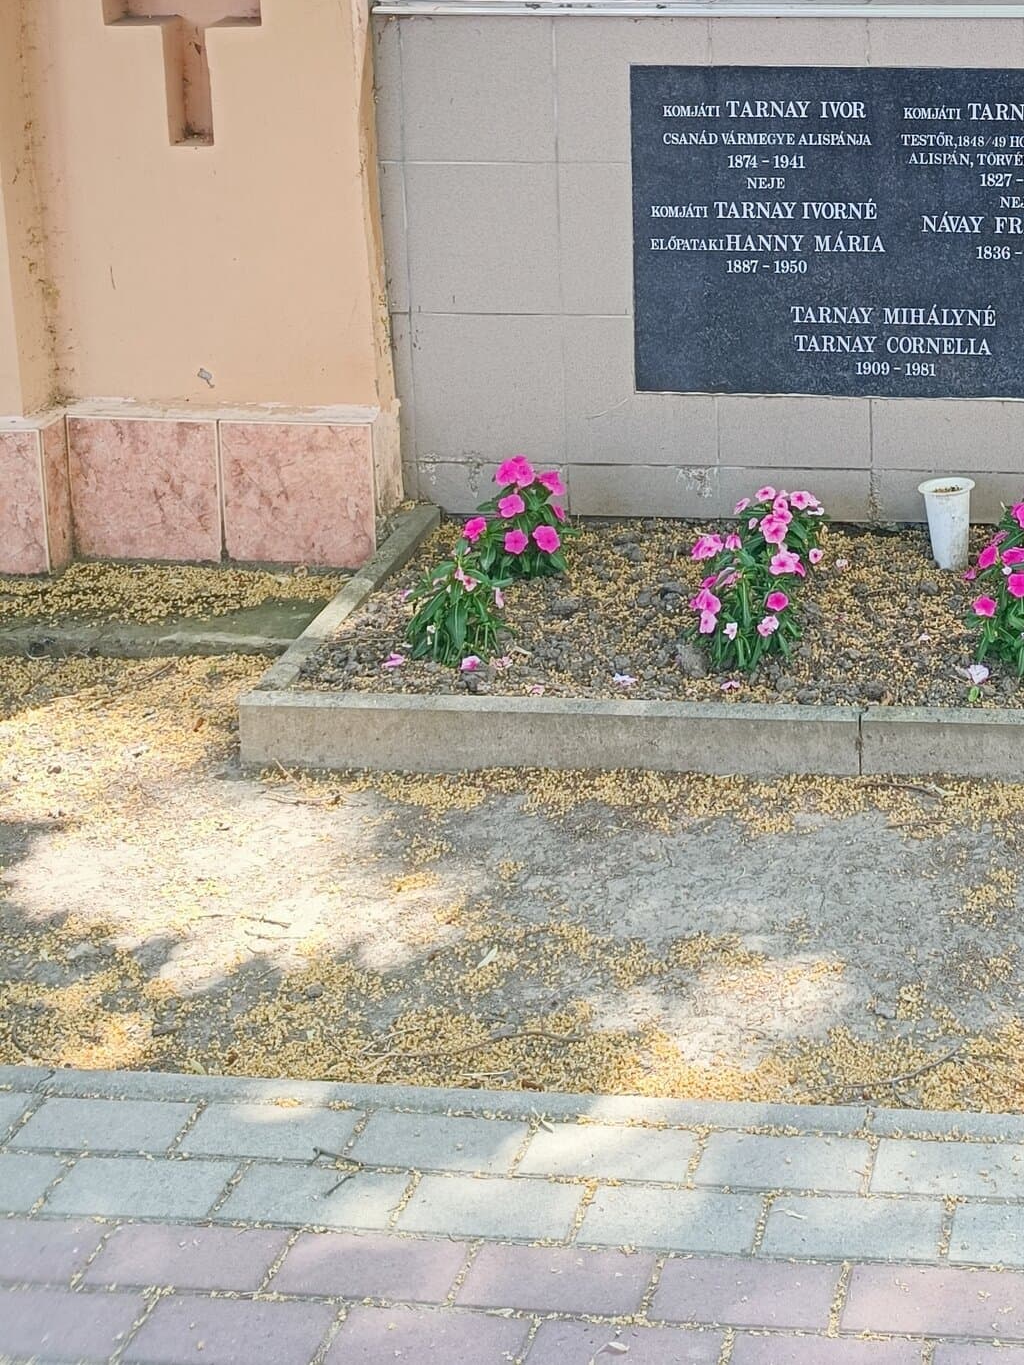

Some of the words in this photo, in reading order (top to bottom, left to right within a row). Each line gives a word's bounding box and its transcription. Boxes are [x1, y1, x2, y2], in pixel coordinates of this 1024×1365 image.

[663, 102, 721, 118] KOMJÁTI
[725, 100, 811, 118] TARNAY
[819, 101, 867, 119] IVOR
[903, 104, 961, 120] KOMJÁTI
[662, 130, 719, 145] CSANÁD
[721, 130, 796, 146] VÁRMEGYE
[797, 131, 873, 146] ALISPÁNJA
[727, 154, 758, 169] 1874
[773, 154, 806, 169] 1941
[908, 150, 974, 168] ALISPÁN,
[746, 177, 786, 190] NEJE
[979, 173, 1013, 188] 1827
[650, 202, 709, 218] KOMJÁTI
[713, 201, 797, 219] TARNAY
[801, 198, 878, 220] IVORNÉ
[921, 211, 985, 234] NÁVAY
[725, 234, 805, 252] HANNY
[813, 230, 886, 253] MÁRIA
[976, 245, 1011, 260] 1836
[726, 259, 759, 274] 1887
[773, 259, 808, 274] 1950
[790, 305, 874, 324] TARNAY
[882, 303, 996, 327] MIHÁLYNÉ
[794, 334, 876, 353] TARNAY
[886, 336, 992, 356] CORNELIA
[855, 361, 890, 376] 1909
[904, 362, 937, 377] 1981
